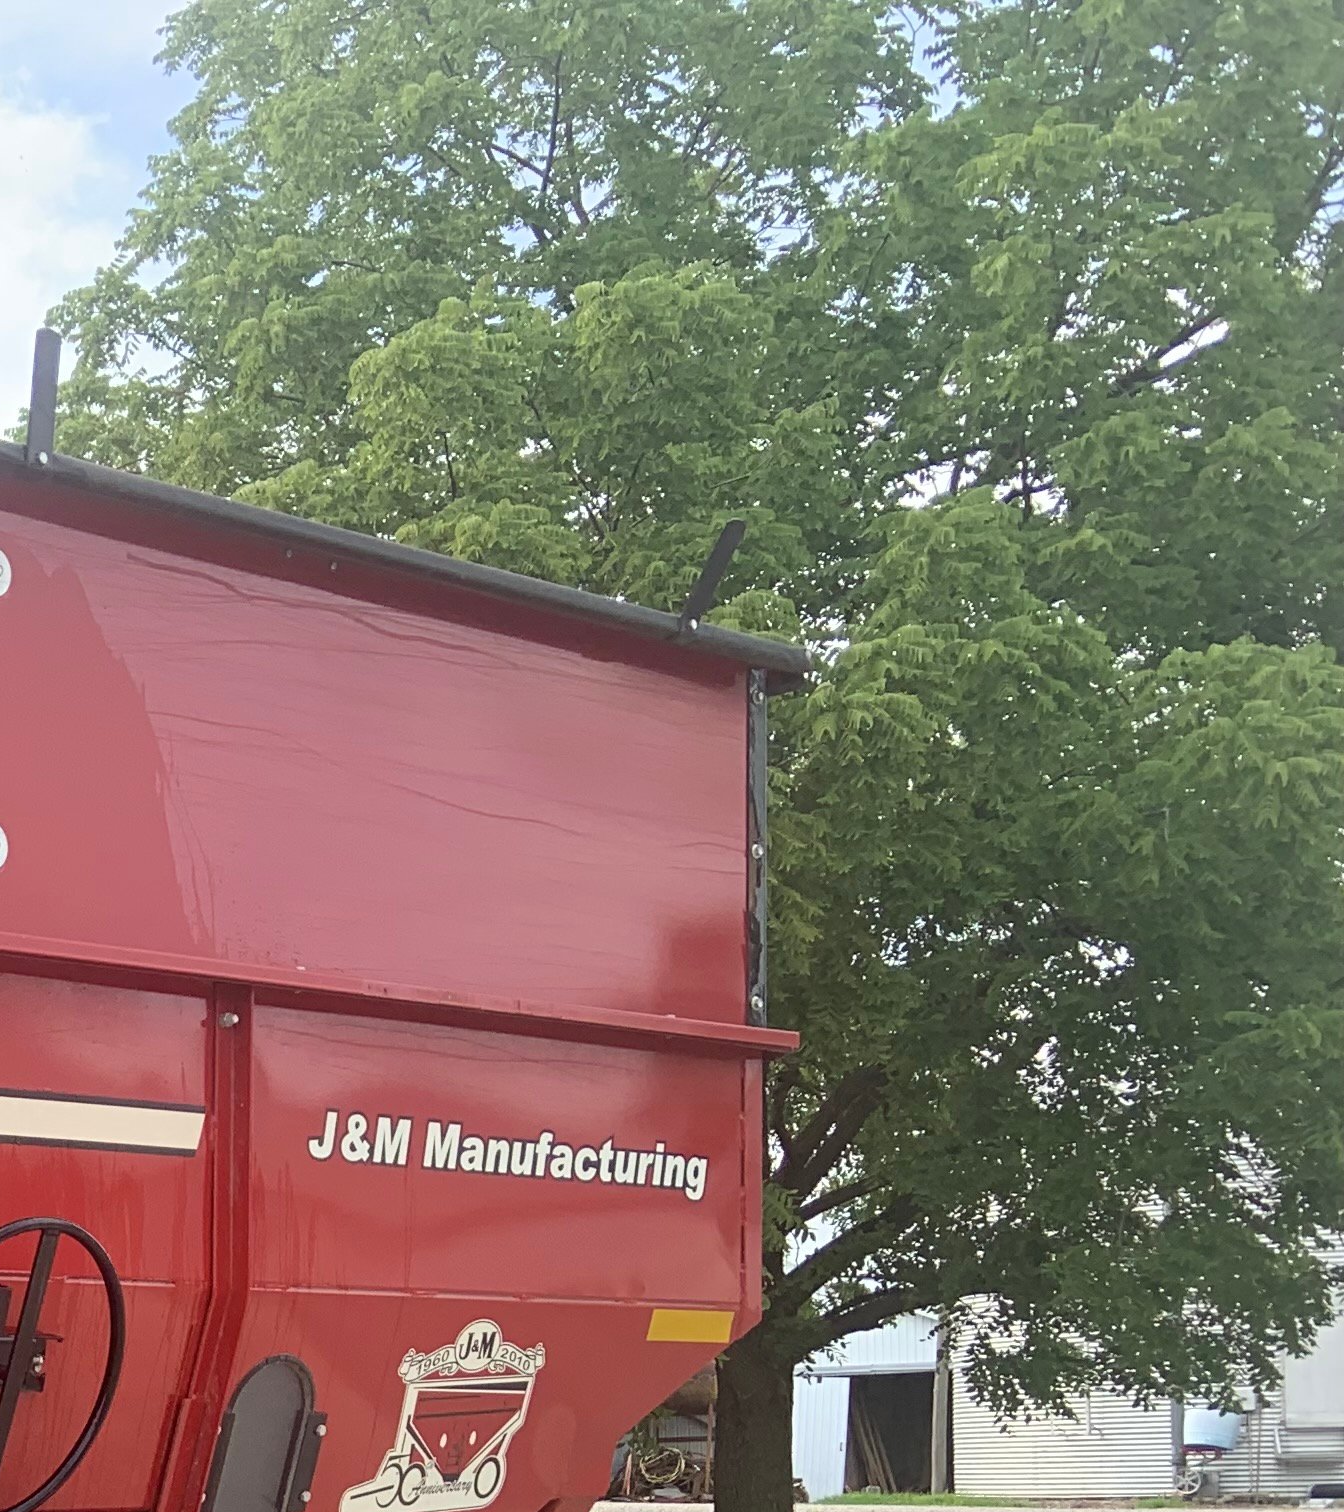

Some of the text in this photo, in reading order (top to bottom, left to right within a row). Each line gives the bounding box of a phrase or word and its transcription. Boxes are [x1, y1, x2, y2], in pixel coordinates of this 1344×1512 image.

[309, 1110, 708, 1200] J&M Manufacturing
[458, 1331, 497, 1360] J&M
[416, 1350, 450, 1376] 1960
[500, 1347, 532, 1372] 2010
